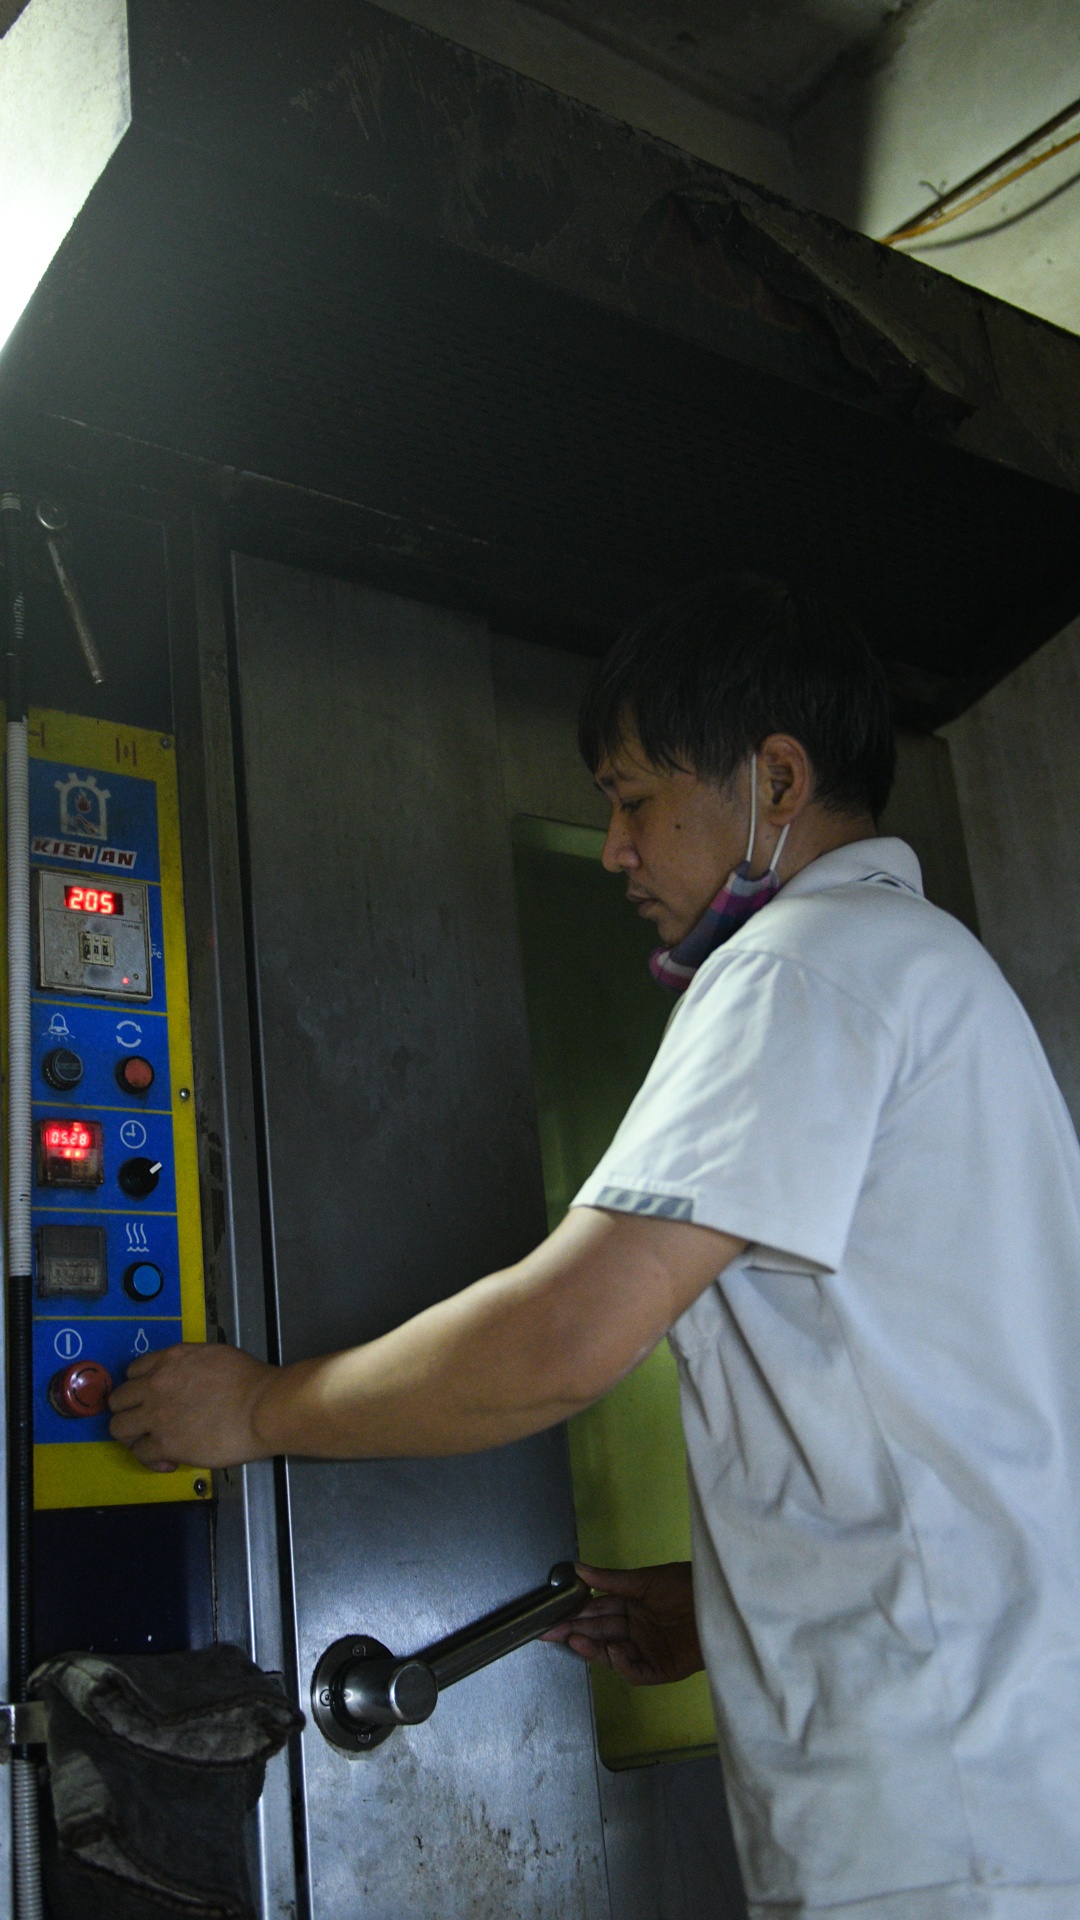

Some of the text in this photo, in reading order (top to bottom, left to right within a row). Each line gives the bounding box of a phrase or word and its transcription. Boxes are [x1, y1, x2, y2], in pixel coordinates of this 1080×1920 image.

[33, 838, 134, 866] KIEN AN
[68, 887, 114, 914] 205
